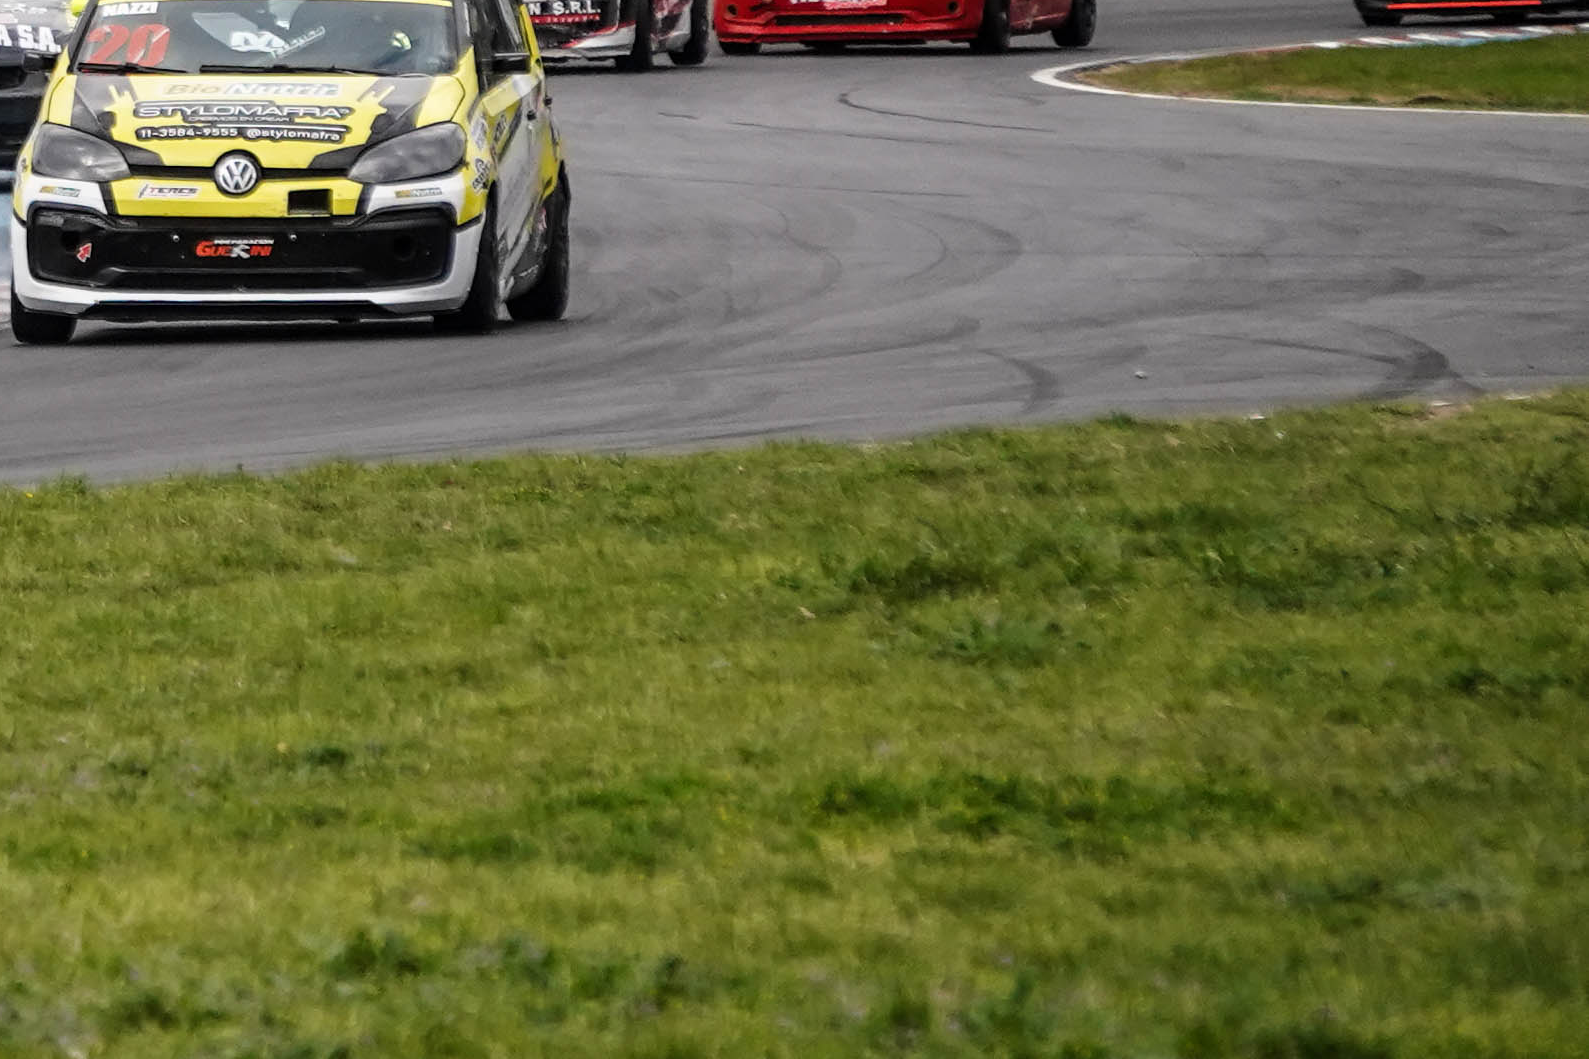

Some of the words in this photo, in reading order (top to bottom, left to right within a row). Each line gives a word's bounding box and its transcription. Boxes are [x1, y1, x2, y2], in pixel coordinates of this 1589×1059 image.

[553, 0, 602, 15] S.R.L.
[17, 25, 62, 53] S.A.
[86, 24, 170, 67] 20
[246, 128, 340, 141] @stylomafra
